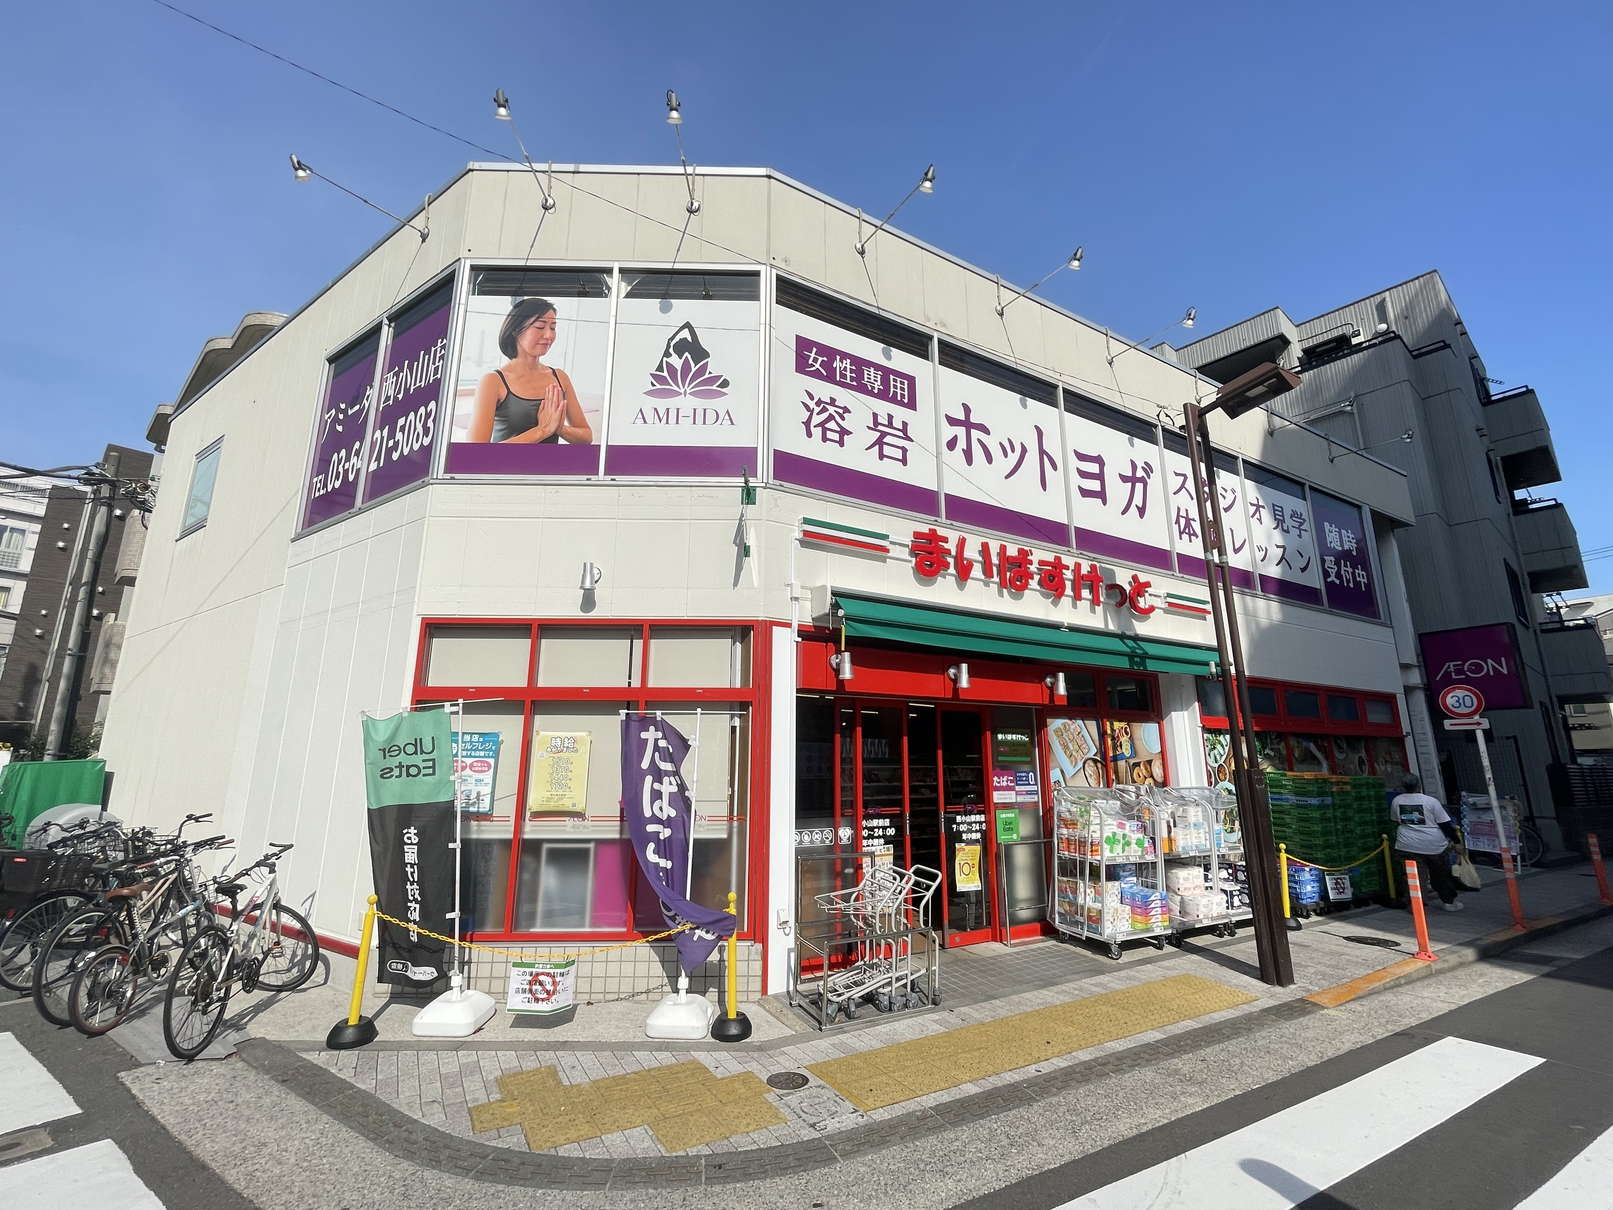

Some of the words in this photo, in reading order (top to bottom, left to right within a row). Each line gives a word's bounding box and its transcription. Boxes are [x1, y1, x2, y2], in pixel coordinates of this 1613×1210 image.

[803, 346, 909, 405] 女性専用
[632, 406, 736, 426] AMI-IDA
[1174, 506, 1311, 574] 体レッスン
[909, 527, 1155, 616] まいばすけっと
[1323, 556, 1368, 592] 受付中
[1450, 694, 1474, 709] 30
[992, 776, 1015, 787] たばこ
